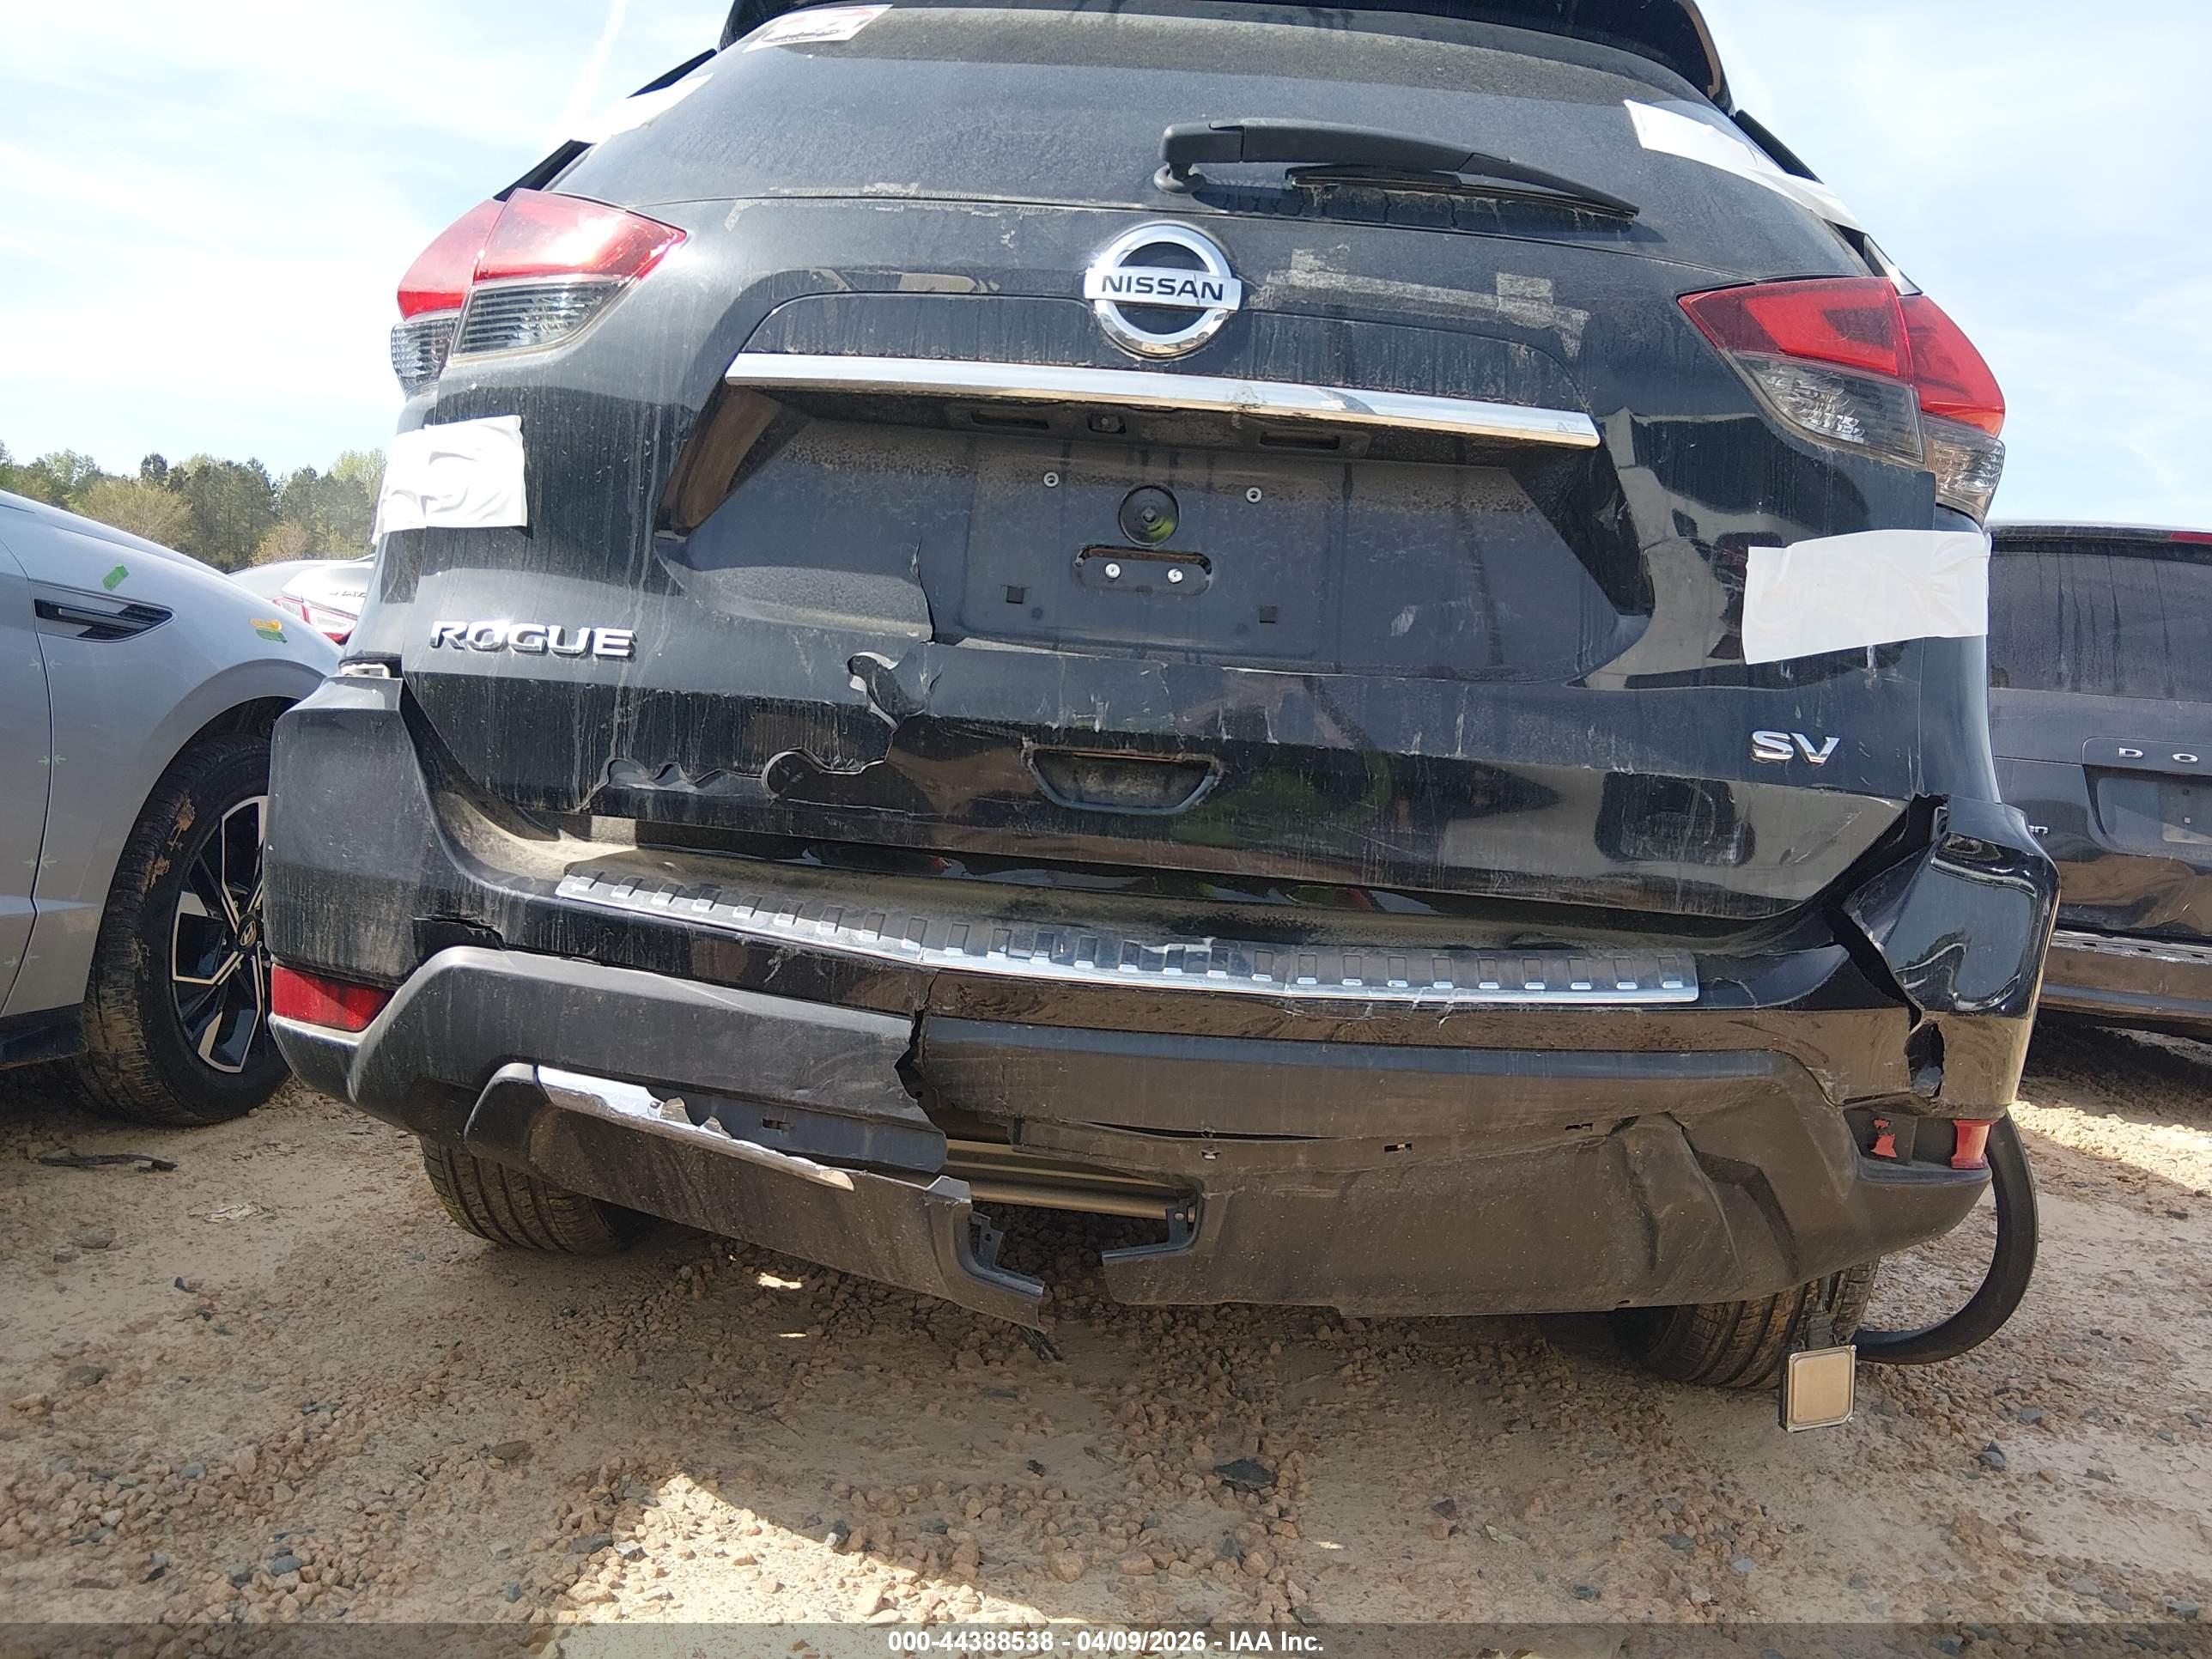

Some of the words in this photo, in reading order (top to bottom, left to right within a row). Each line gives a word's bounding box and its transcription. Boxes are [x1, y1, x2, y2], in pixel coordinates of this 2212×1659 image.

[1102, 275, 1224, 301] NISSAN
[430, 620, 636, 661] ROGUE
[1752, 730, 1841, 765] SV
